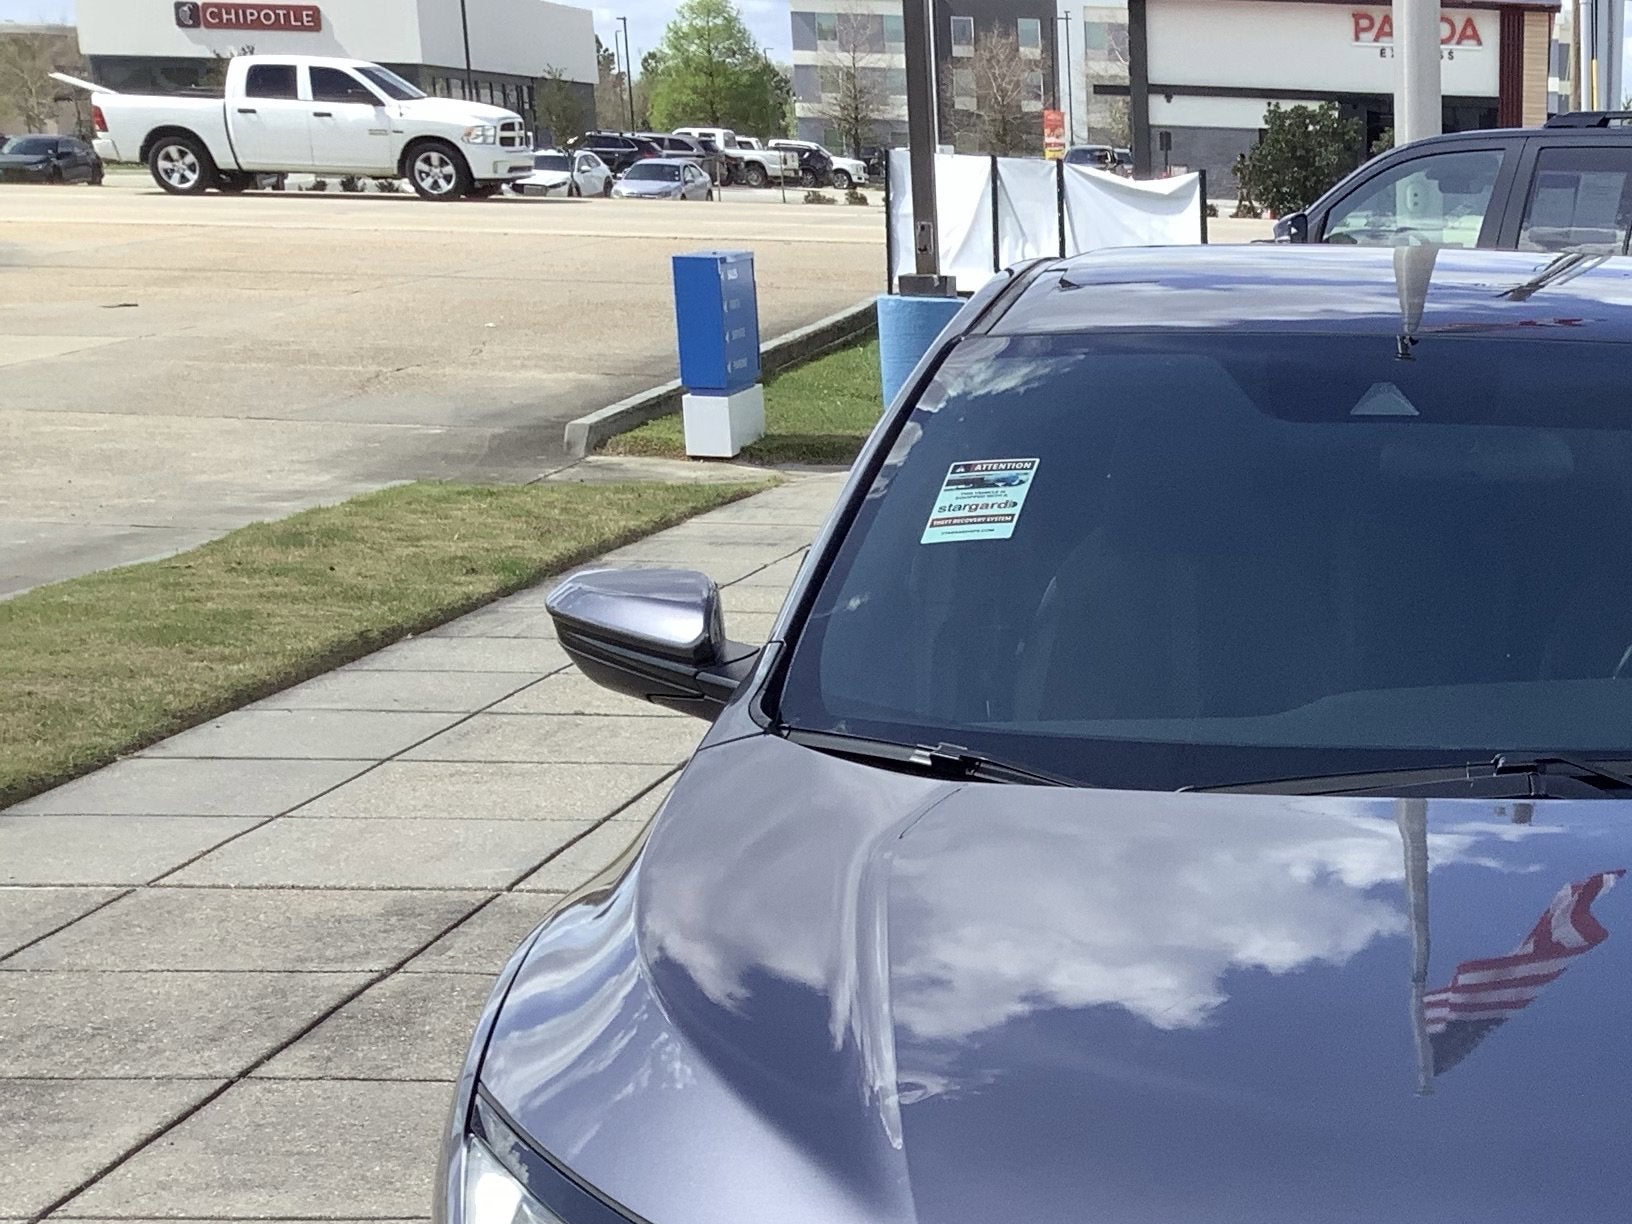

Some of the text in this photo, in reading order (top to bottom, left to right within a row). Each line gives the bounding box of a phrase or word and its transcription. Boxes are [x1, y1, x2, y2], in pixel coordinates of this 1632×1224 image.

[206, 8, 314, 26] CHIPOTLE
[1352, 11, 1483, 46] PADA
[974, 462, 1032, 471] ATTENTION
[938, 500, 1009, 513] stargard
